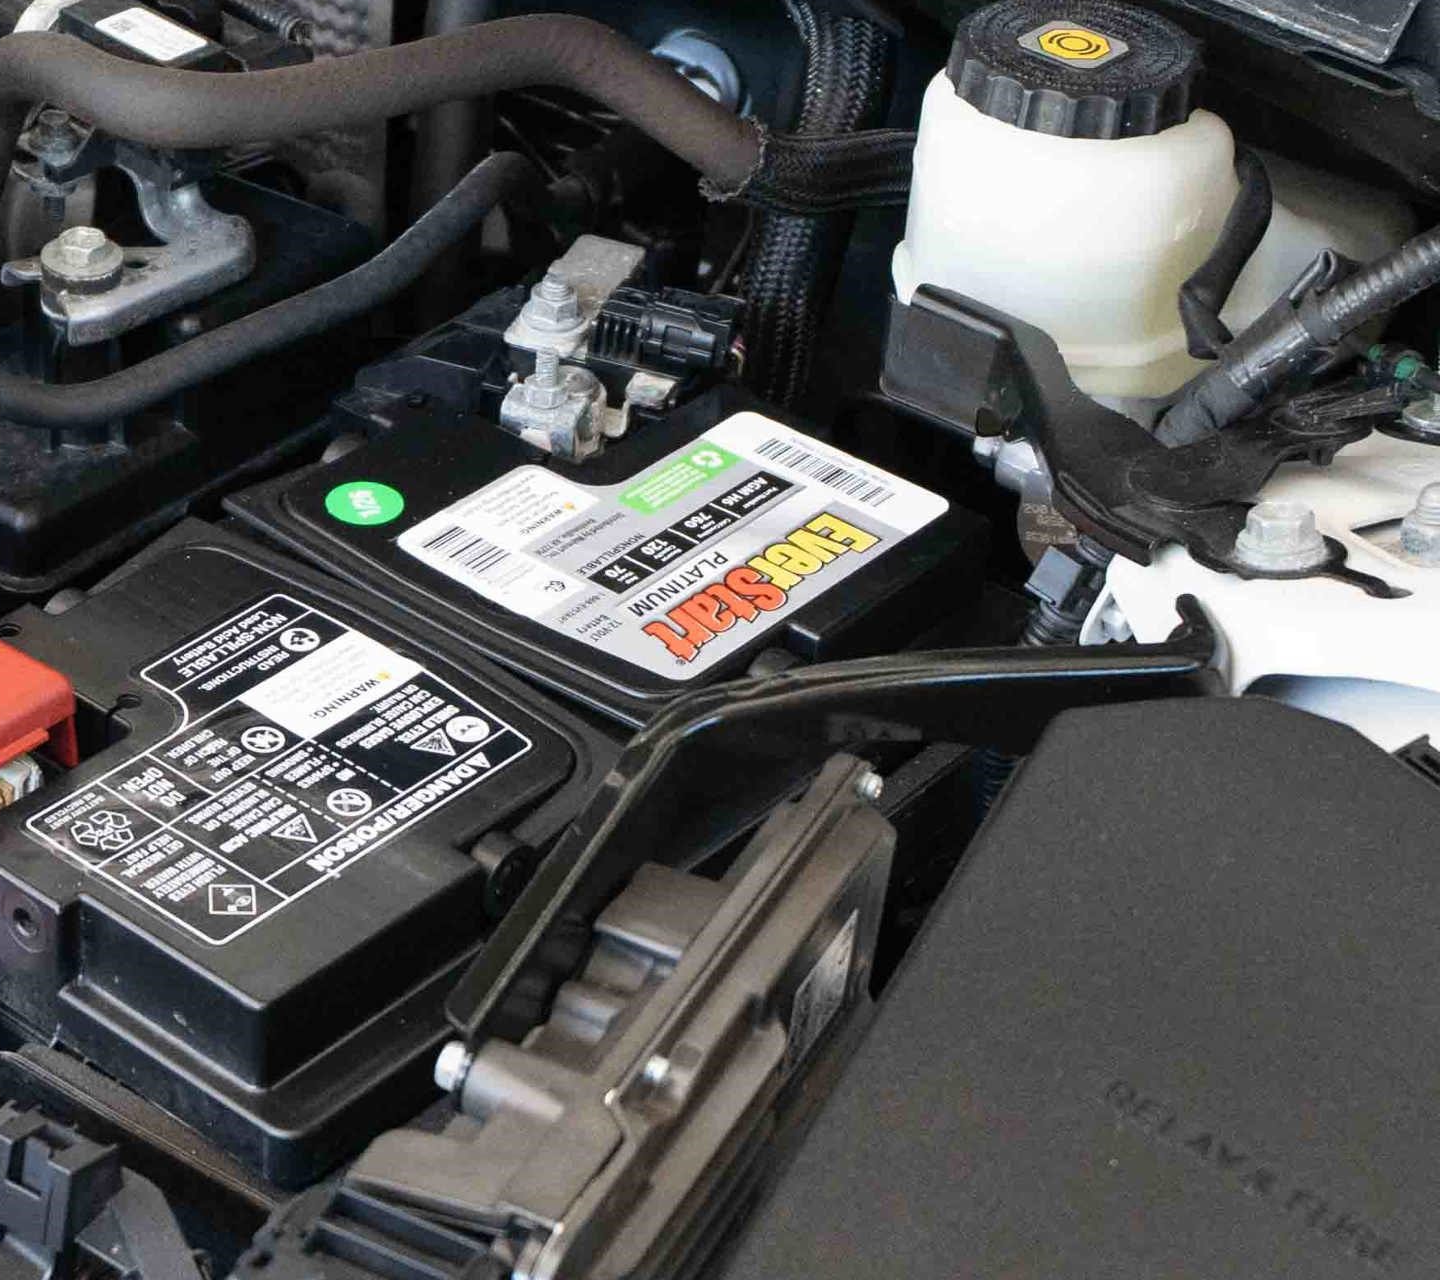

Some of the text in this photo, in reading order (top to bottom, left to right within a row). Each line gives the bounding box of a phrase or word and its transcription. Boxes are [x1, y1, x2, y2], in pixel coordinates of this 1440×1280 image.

[718, 476, 767, 506] AGM H6
[682, 511, 713, 528] 760
[575, 533, 645, 574] NONSPILLABLE
[638, 538, 668, 555] 120
[603, 564, 627, 577] 70
[625, 551, 730, 617] PLATINUM
[637, 511, 882, 663] EverStart
[171, 609, 269, 666] Lead Acid Battery
[573, 614, 609, 634] Battery
[587, 619, 623, 642] 12-VOLT
[176, 612, 288, 678] NON-SPILLABLE
[256, 650, 290, 671] READ
[196, 643, 280, 692] INSTRUCTIONS.
[308, 678, 380, 720] WARNING:
[400, 683, 419, 695] OR
[333, 689, 431, 749] CAN CAUSE BLINDNESS
[356, 695, 446, 749] EXPLOSIVE GASES
[420, 703, 461, 729] SHIELD
[162, 728, 215, 759] CHILDREN.
[180, 736, 229, 767] REACH OF
[204, 745, 243, 768] OF THE
[208, 753, 257, 783] KEEP OUT
[263, 749, 310, 778] SMOKING
[281, 756, 323, 782] FLAMES
[294, 763, 336, 789] SPARKS
[116, 765, 165, 794] OPEN.
[138, 777, 176, 802] NOT
[216, 780, 258, 807] SEVERE
[156, 789, 187, 808] DO
[200, 787, 271, 832] BLINDNESS OR
[228, 795, 283, 831] CAN CAUSE
[217, 802, 298, 854] SULFURIC ACID
[304, 762, 478, 873] DANGER/POISON
[118, 833, 173, 866] HELP FAST.
[119, 838, 185, 880] GET MEDICAL
[173, 850, 205, 870] WITH
[150, 856, 216, 899] IMMEDIATELY
[166, 863, 228, 903] FLUSH EYES
[1104, 1080, 1250, 1170] RELAY
